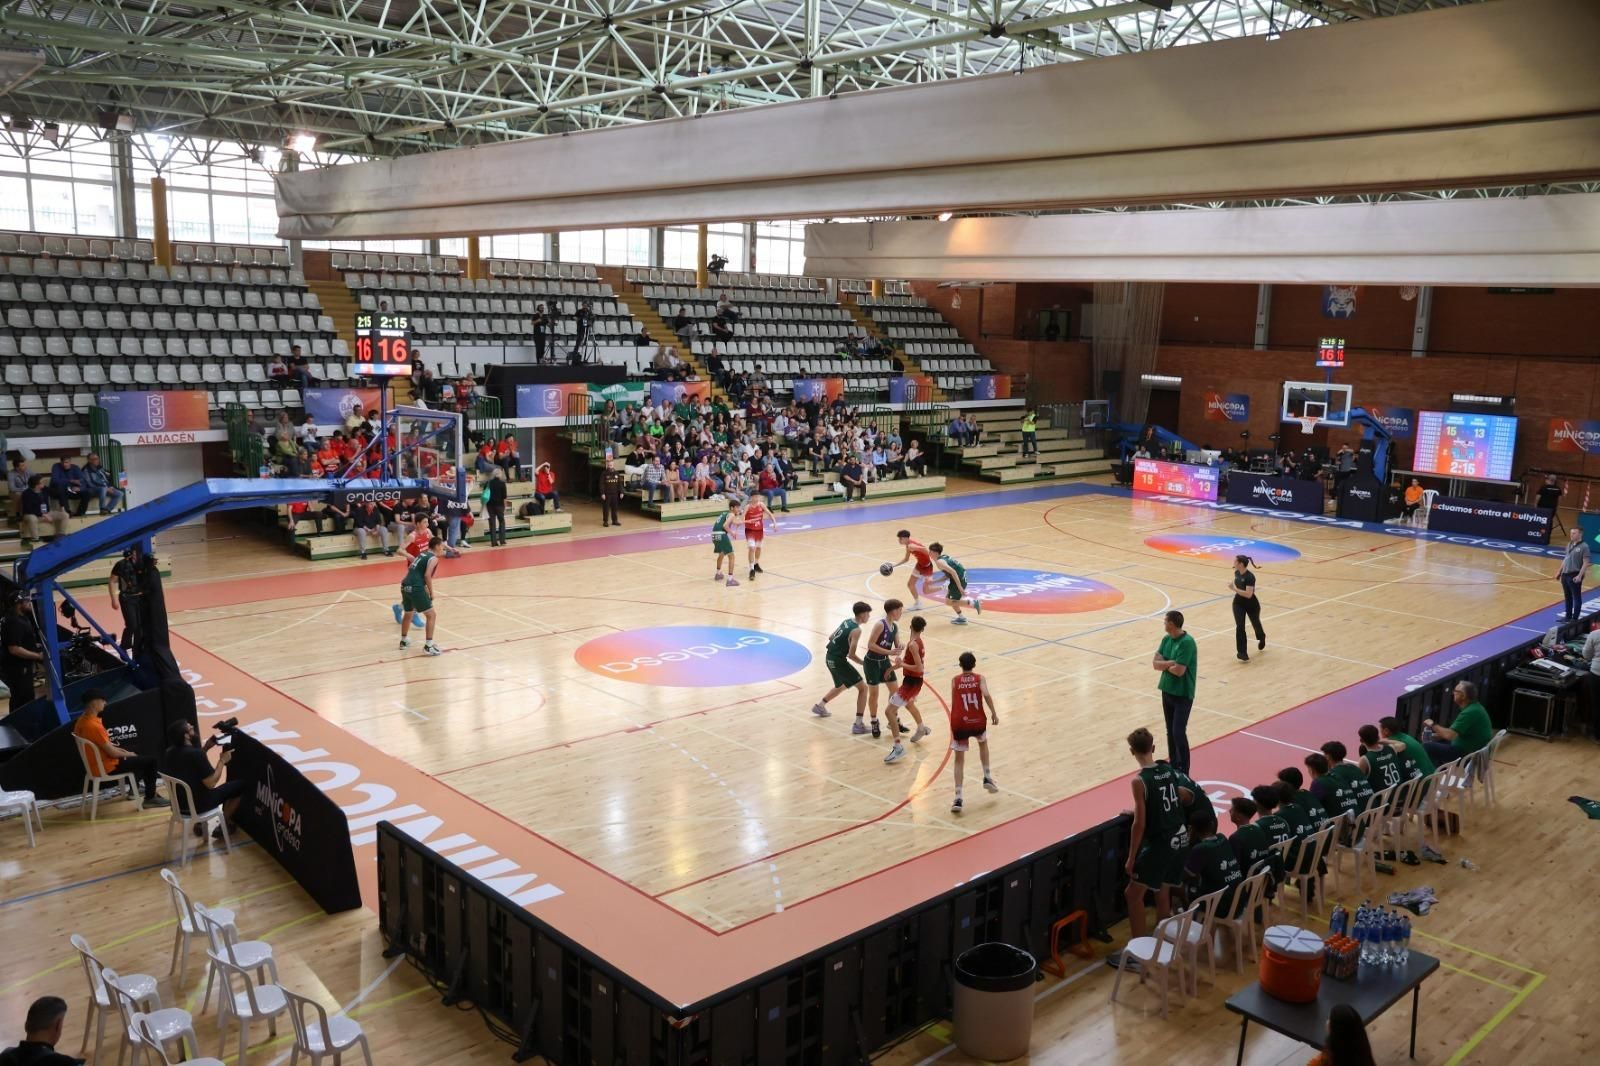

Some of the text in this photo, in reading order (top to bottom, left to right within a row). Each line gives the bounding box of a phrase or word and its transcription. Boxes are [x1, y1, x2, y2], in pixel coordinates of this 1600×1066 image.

[357, 316, 371, 327] 2:15
[380, 316, 407, 328] 2:15
[357, 338, 371, 361] 16
[378, 338, 407, 362] 16
[1320, 349, 1335, 361] 16
[137, 431, 195, 444] ALMACÉN
[1446, 426, 1457, 436] 15
[1474, 428, 1485, 438] 13
[1554, 430, 1600, 441] MINiCOP
[1450, 461, 1475, 475] 2:15
[1141, 474, 1153, 485] 15
[1198, 481, 1211, 492] 13
[346, 489, 401, 502] endesa
[1432, 503, 1548, 524] actuamos contra el bullying
[600, 635, 770, 674] endesa
[961, 693, 979, 711] 14
[107, 724, 137, 737] COPA
[1380, 762, 1401, 786] 36
[1159, 783, 1178, 812] 34
